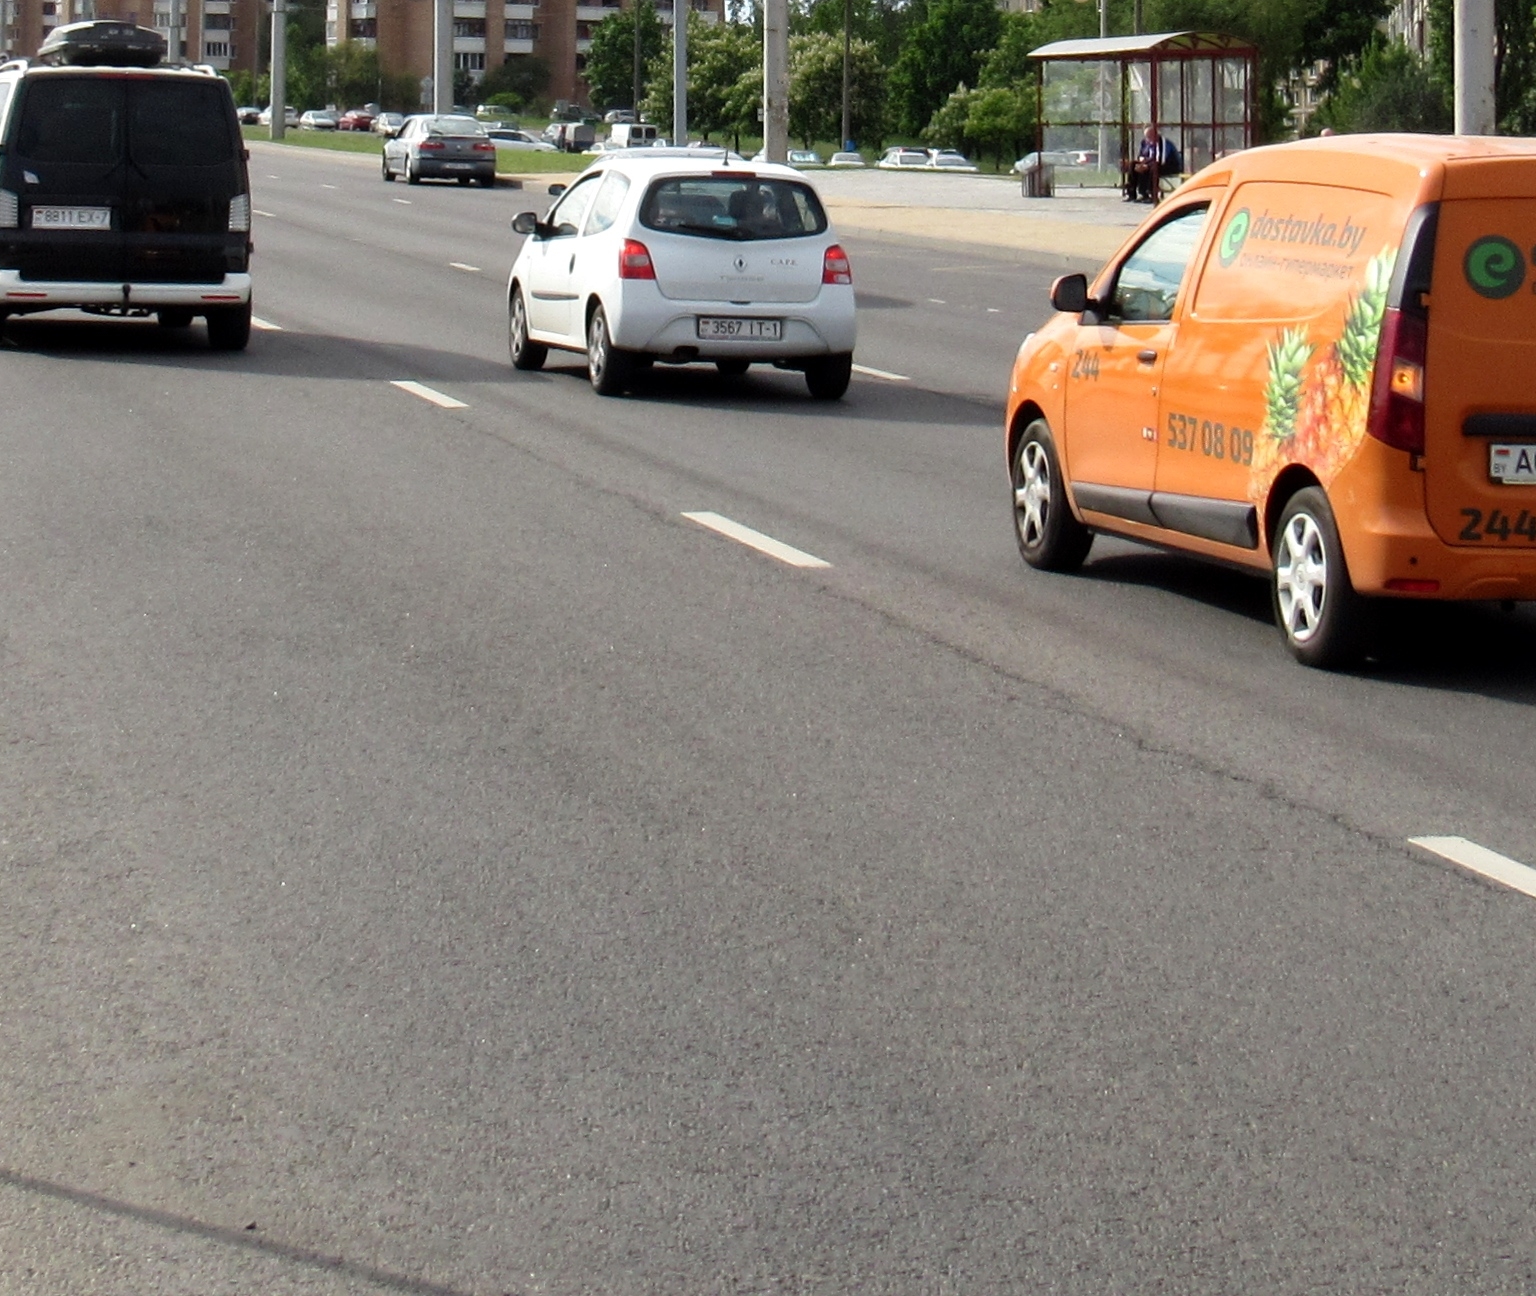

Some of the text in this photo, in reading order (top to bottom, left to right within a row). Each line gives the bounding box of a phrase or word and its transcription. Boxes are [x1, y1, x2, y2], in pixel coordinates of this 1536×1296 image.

[1250, 208, 1368, 259] dostavka.by
[712, 320, 742, 335] 3567
[1072, 349, 1100, 382] 244
[1168, 412, 1254, 466] 537 08 09
